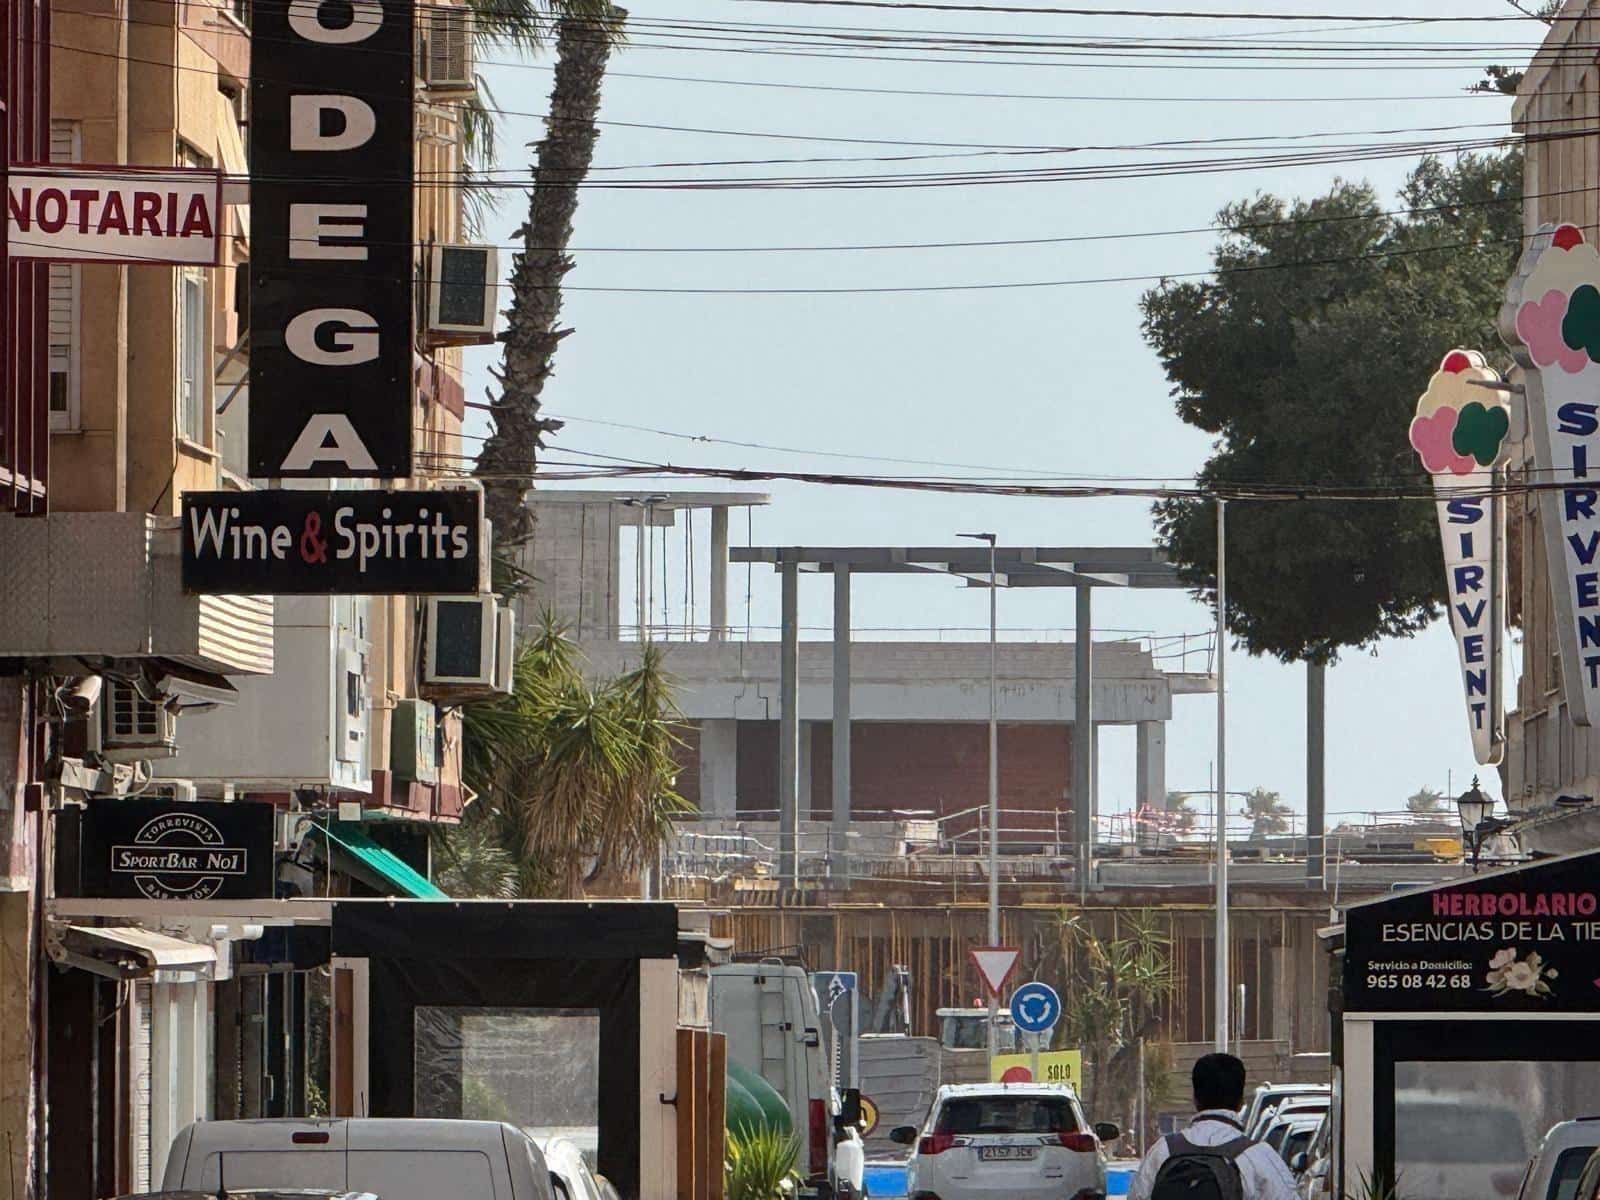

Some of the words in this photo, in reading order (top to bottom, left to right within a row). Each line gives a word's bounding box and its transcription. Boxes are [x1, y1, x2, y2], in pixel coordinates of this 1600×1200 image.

[8, 187, 213, 238] NOTARIA
[190, 507, 292, 560] Wine
[300, 511, 328, 563] &
[335, 506, 468, 573] Spirits
[1446, 498, 1488, 730] SIRVENT
[1432, 893, 1597, 916] HERBOLARIO
[1382, 922, 1495, 942] ESENCIAS
[1501, 921, 1533, 941] DE
[1537, 922, 1566, 941] LA
[1367, 960, 1409, 971] Servicio
[1366, 974, 1398, 989] 965
[1402, 974, 1423, 989] 08
[1425, 974, 1447, 989] 42
[1450, 974, 1471, 989] 68
[1048, 1064, 1071, 1080] SOLO
